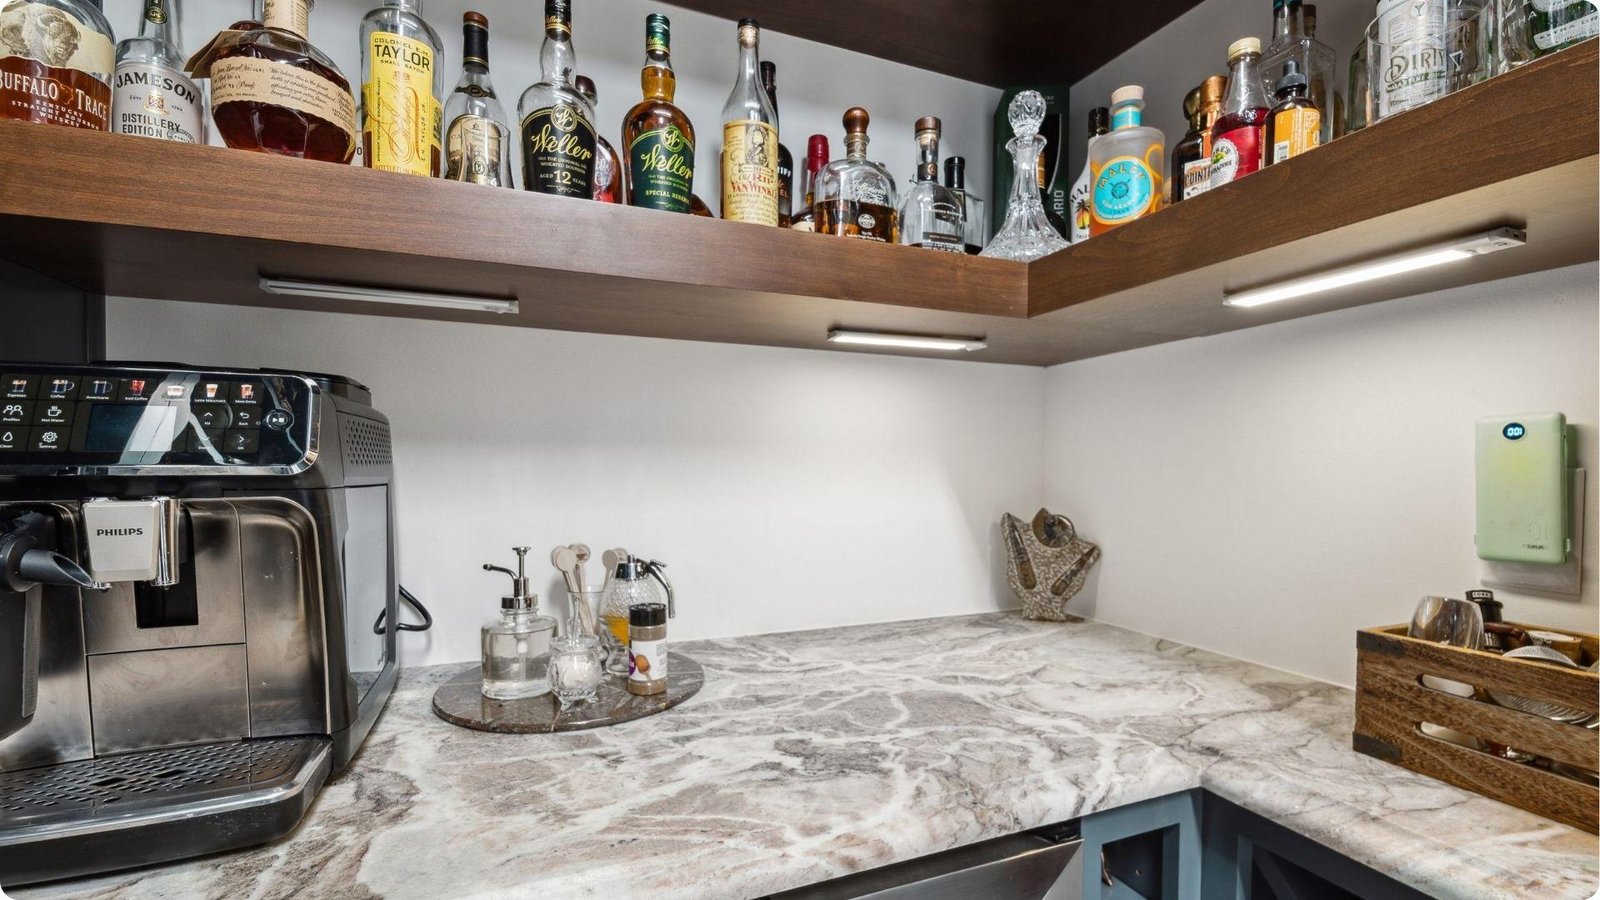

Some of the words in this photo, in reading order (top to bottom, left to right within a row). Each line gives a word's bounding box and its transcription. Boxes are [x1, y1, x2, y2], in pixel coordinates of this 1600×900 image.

[374, 44, 430, 72] TAYLOR
[380, 59, 400, 67] SMALL
[404, 63, 425, 74] BATCH
[0, 68, 59, 101] BUFFALO
[75, 88, 107, 121] TRACE
[116, 71, 196, 105] JAMESON
[11, 100, 61, 116] STRAIGHT
[35, 99, 84, 119] KENTUCKY
[39, 112, 81, 128] WHISKEY
[122, 112, 181, 133] DISTILLERY
[122, 124, 163, 138] EDITION
[531, 123, 593, 160] Weller
[640, 143, 692, 179] Weller
[553, 170, 572, 185] 12
[753, 173, 774, 185] RIP
[645, 190, 671, 198] SPECIAL
[96, 527, 144, 537] PHILIPS
